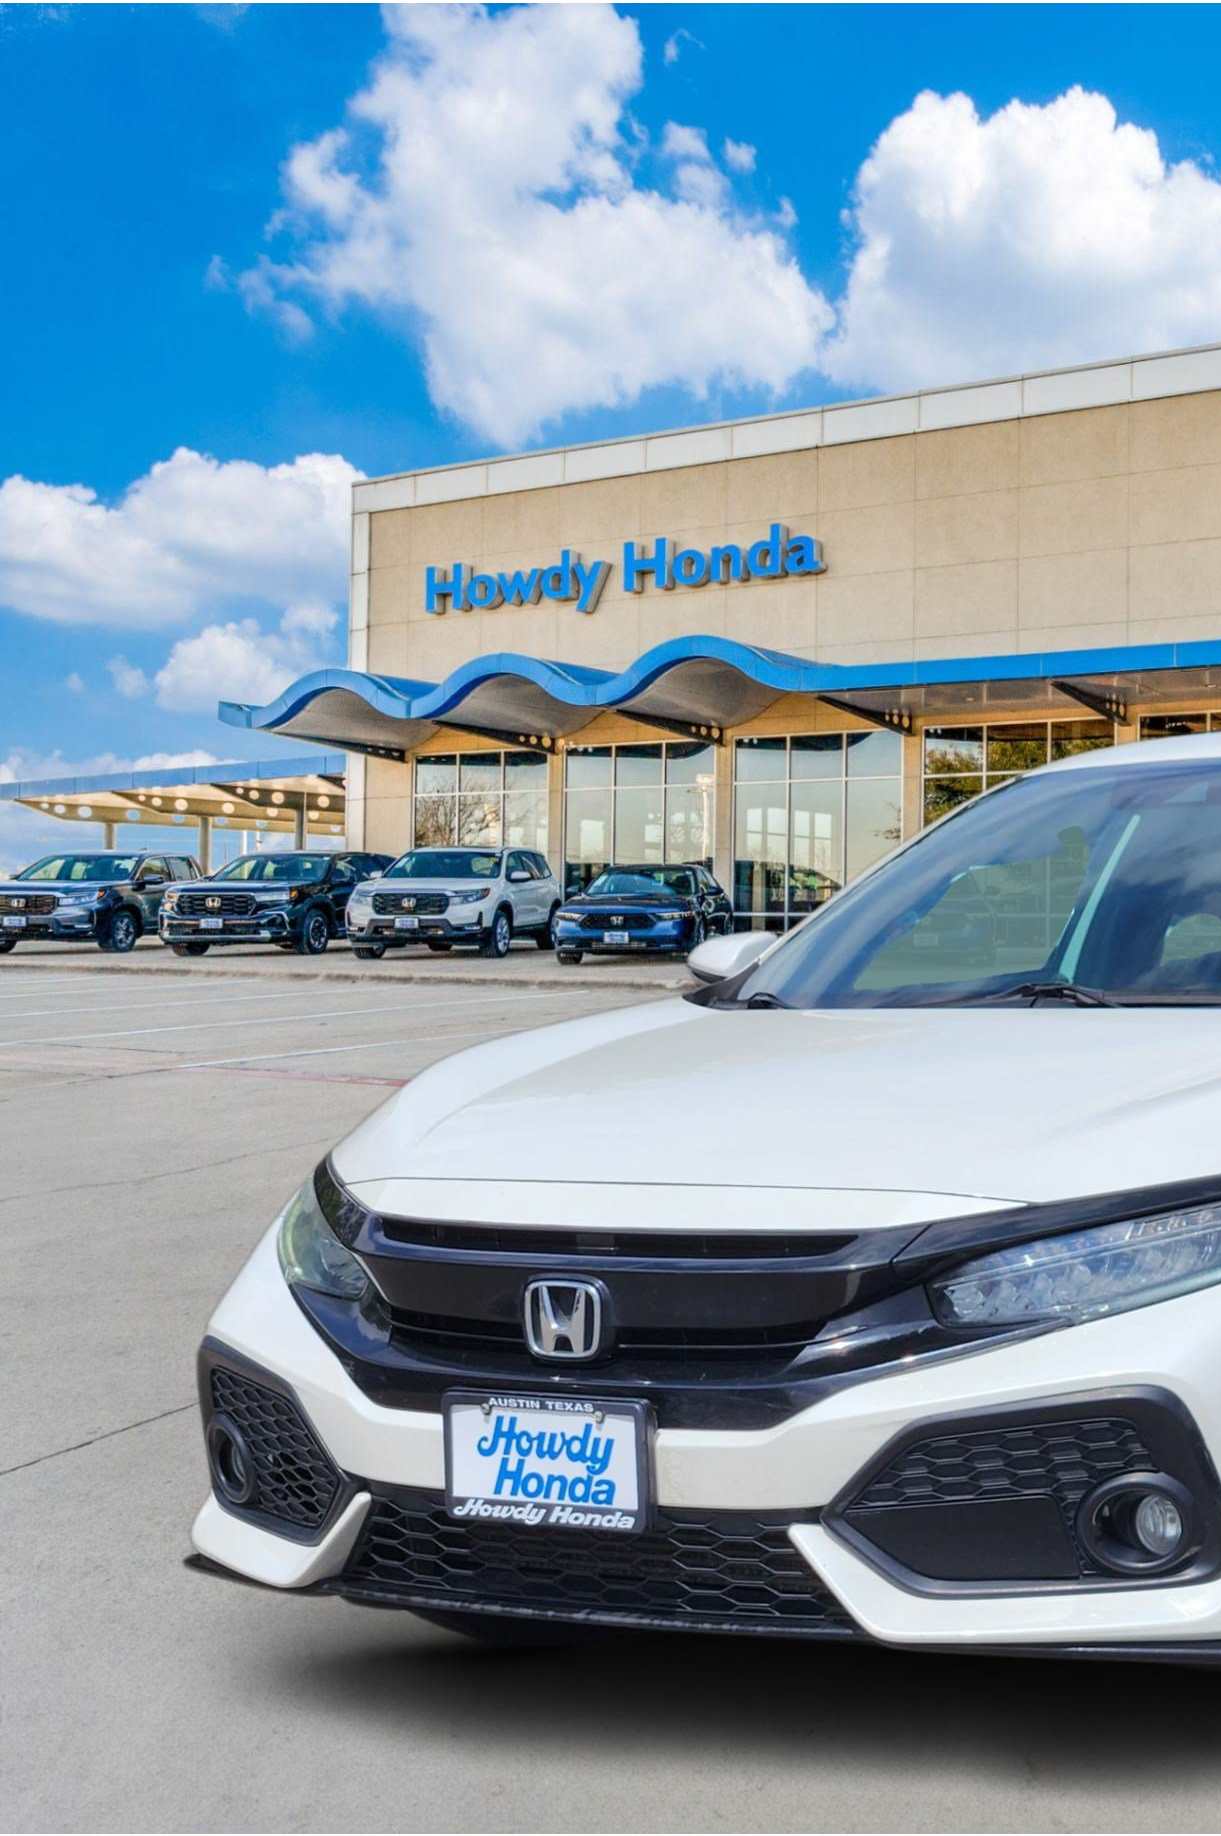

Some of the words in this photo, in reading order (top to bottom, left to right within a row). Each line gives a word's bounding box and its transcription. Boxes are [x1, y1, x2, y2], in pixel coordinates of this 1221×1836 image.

[425, 549, 613, 614] Howdy
[623, 523, 827, 593] Honda
[488, 1397, 540, 1410] AUSTIN
[545, 1401, 594, 1412] TEXAS
[477, 1415, 615, 1475] Howdy
[493, 1457, 616, 1506] Honda
[453, 1498, 547, 1526] Howdy
[549, 1505, 636, 1529] Honda
